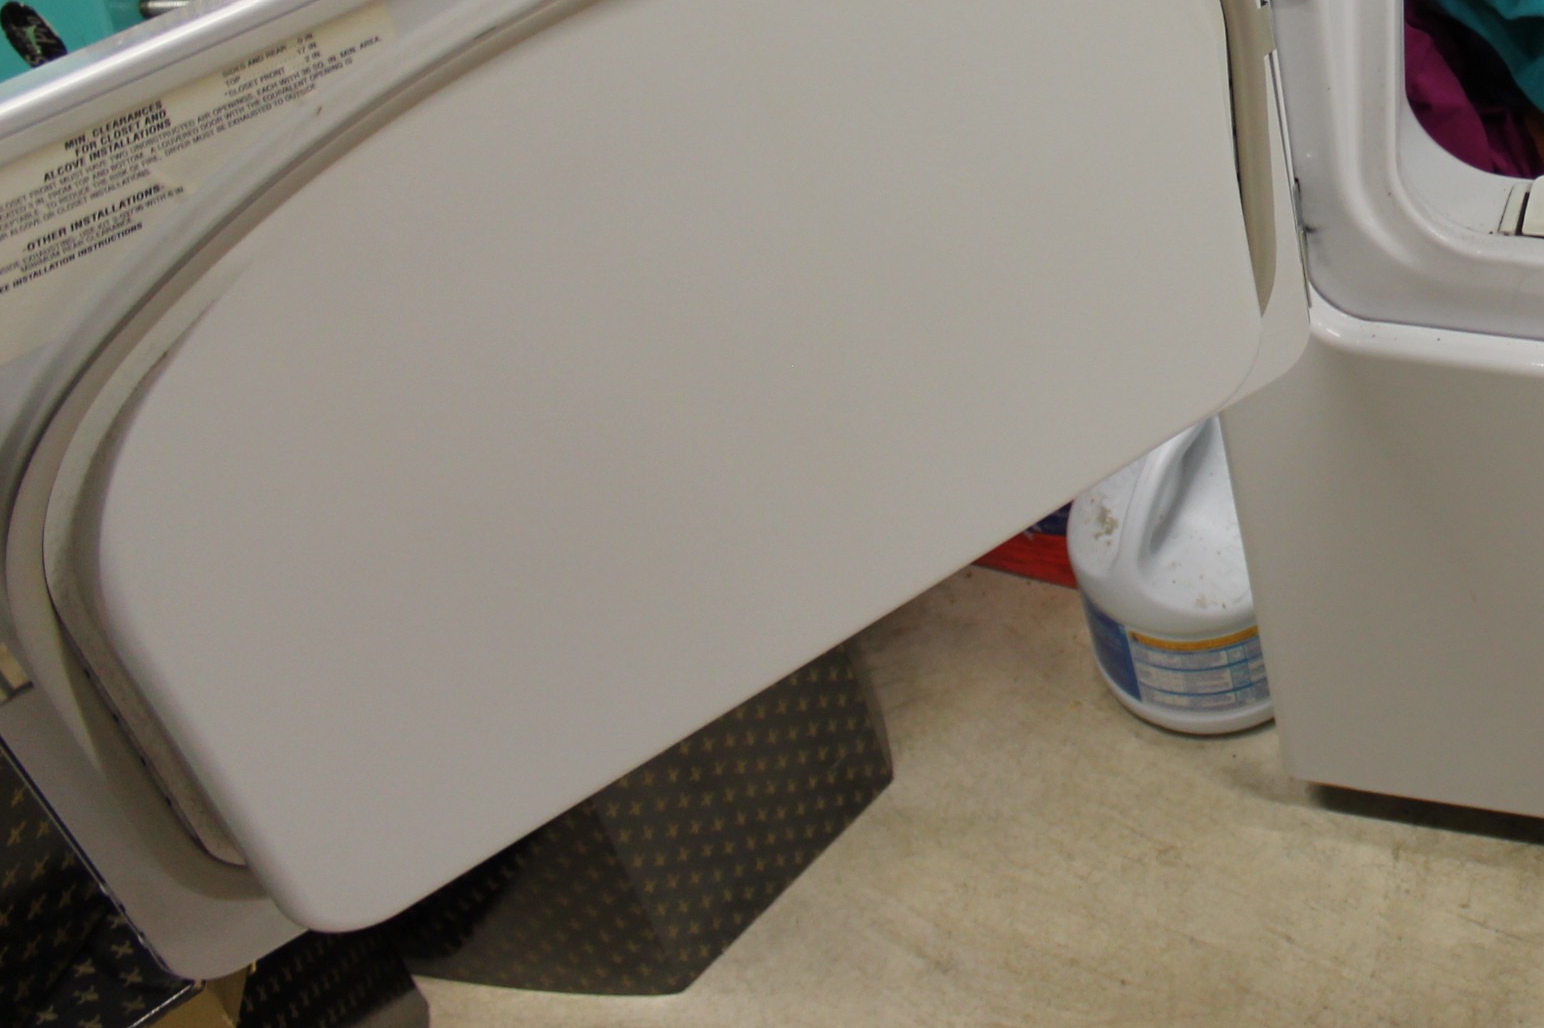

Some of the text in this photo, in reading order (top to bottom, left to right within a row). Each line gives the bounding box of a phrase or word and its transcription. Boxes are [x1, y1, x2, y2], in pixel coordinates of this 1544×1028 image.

[266, 44, 287, 59] REAR
[226, 105, 245, 119] WITH
[247, 98, 260, 110] THE
[263, 78, 307, 103] EQUIVALENT
[310, 61, 343, 81] OPENING
[257, 72, 300, 96] EACH WITH
[260, 66, 285, 83] FRONT
[75, 109, 167, 157] FOR CLOSET AND
[92, 100, 162, 138] CLEARANCES
[43, 118, 172, 182] ALCOVE INSTALLATIONS
[13, 222, 143, 288] INSTALLATION INSTRUCTIONS
